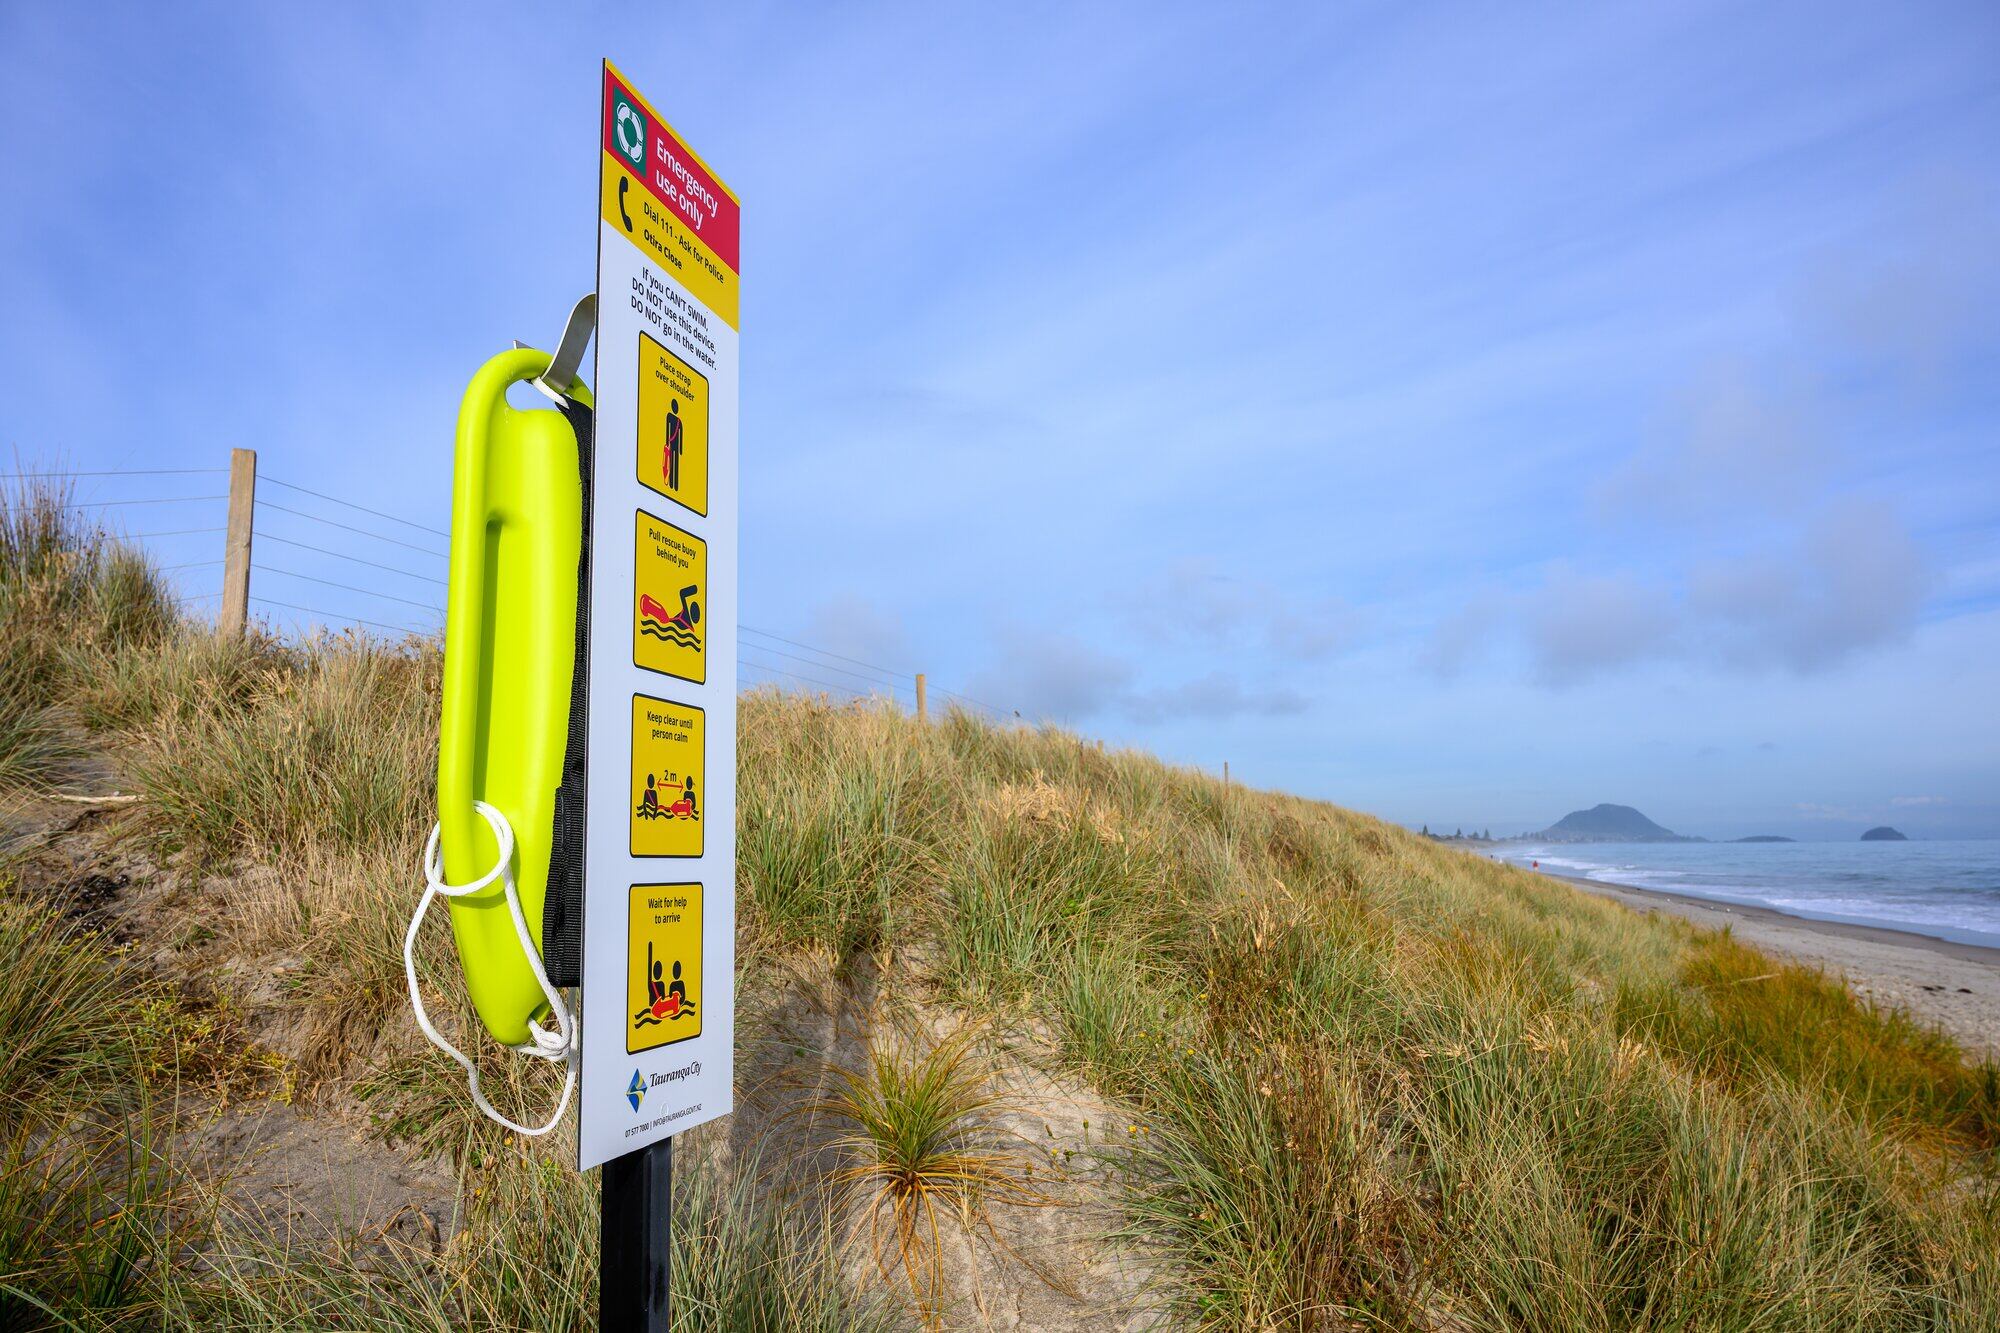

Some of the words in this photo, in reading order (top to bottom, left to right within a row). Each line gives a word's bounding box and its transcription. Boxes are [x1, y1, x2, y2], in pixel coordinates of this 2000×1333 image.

[657, 137, 718, 218] Emergency
[656, 169, 677, 202] use
[679, 194, 703, 230] only
[644, 201, 659, 225] Dial
[661, 218, 673, 237] 111
[679, 235, 692, 255] Ask
[693, 247, 703, 264] for
[704, 258, 724, 283] Police
[644, 229, 662, 253] Otira
[664, 246, 683, 270] Close
[642, 267, 649, 281] If
[649, 274, 663, 294] you
[665, 286, 687, 311] CAN'T
[687, 305, 708, 332] SWIM,
[632, 277, 644, 296] DO
[646, 288, 663, 311] NOT
[664, 305, 677, 323] use
[678, 314, 692, 334] this
[693, 327, 716, 355] device,
[631, 295, 643, 314] DO
[645, 306, 662, 328] NOT
[663, 322, 672, 336] go
[673, 327, 680, 343] in
[682, 335, 694, 353] the
[695, 346, 717, 370] water.
[656, 370, 669, 383] over
[670, 379, 694, 401] shoulder
[660, 356, 675, 375] Place
[676, 370, 691, 387] strap
[649, 527, 660, 541] Pull
[662, 535, 681, 551] rescue
[682, 542, 696, 560] buoy
[656, 545, 677, 563] behind
[678, 557, 689, 568] you
[646, 710, 662, 726] Keep
[663, 714, 678, 726] clear
[679, 718, 693, 729] until
[652, 728, 673, 740] person
[674, 732, 688, 743] calm
[664, 769, 669, 781] 2
[670, 772, 677, 782] m
[648, 897, 663, 908] Wait
[664, 897, 673, 908] for
[674, 896, 687, 909] help
[654, 914, 661, 924] to
[662, 912, 680, 924] arrive
[649, 1066, 690, 1088] Tauranga
[690, 1060, 702, 1076] City
